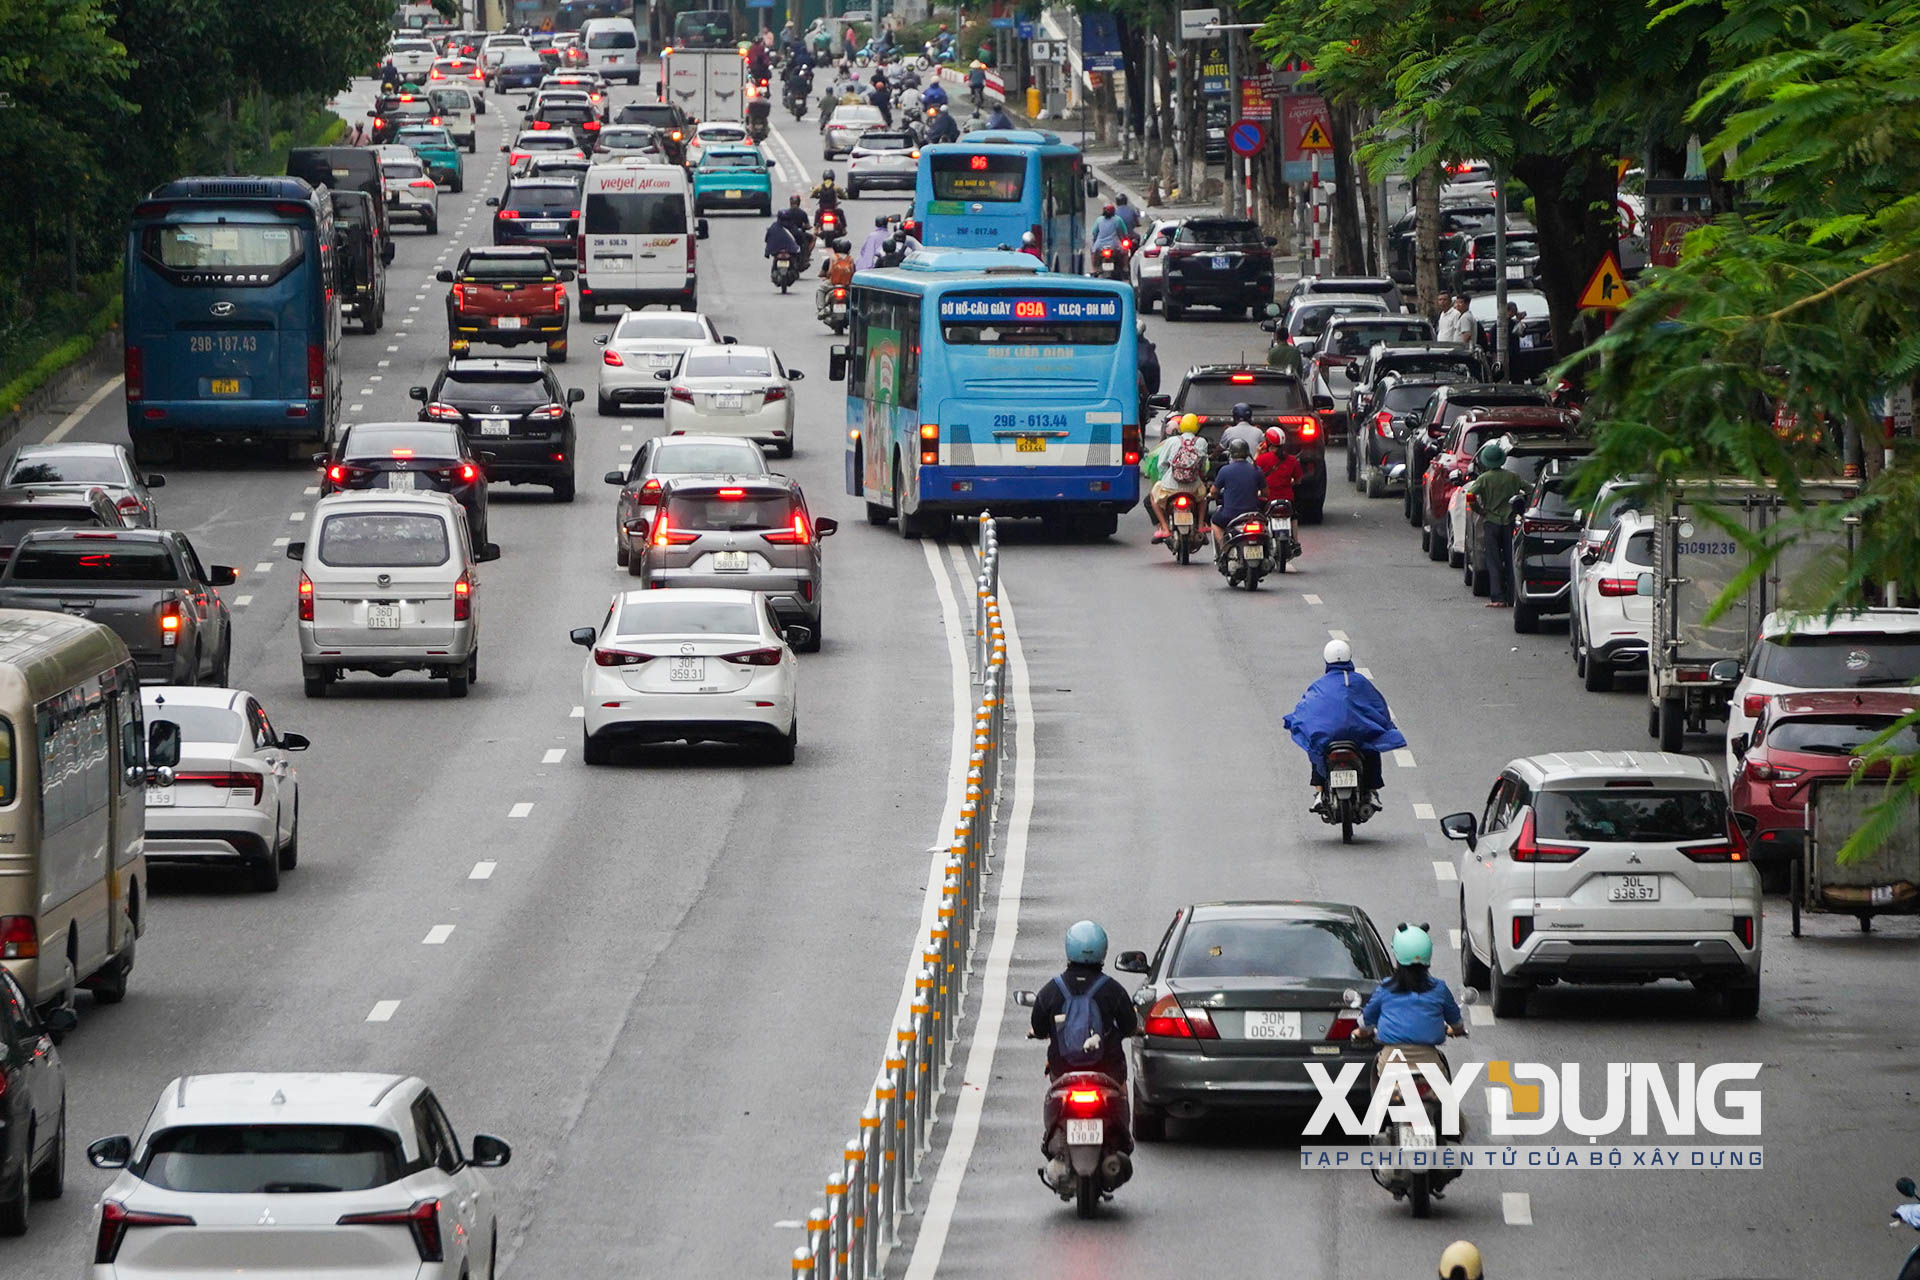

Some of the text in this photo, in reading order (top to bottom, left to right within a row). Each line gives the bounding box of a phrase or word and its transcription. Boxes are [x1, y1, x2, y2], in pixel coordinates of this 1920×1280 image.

[1203, 63, 1229, 77] HOTEL
[971, 155, 988, 170] 96
[181, 274, 270, 283] UNIVERSE
[1017, 302, 1045, 316] 09A
[190, 336, 257, 351] 29B-187.43
[994, 415, 1068, 427] 29B 613.44
[1678, 542, 1737, 556] 51C91236
[375, 607, 393, 617] 36D
[369, 617, 398, 628] 015.11
[679, 657, 696, 669] 30F
[671, 668, 703, 680] 359.31
[1622, 876, 1644, 888] 30L
[1261, 1011, 1285, 1025] 30M
[1251, 1025, 1295, 1038] 005.47
